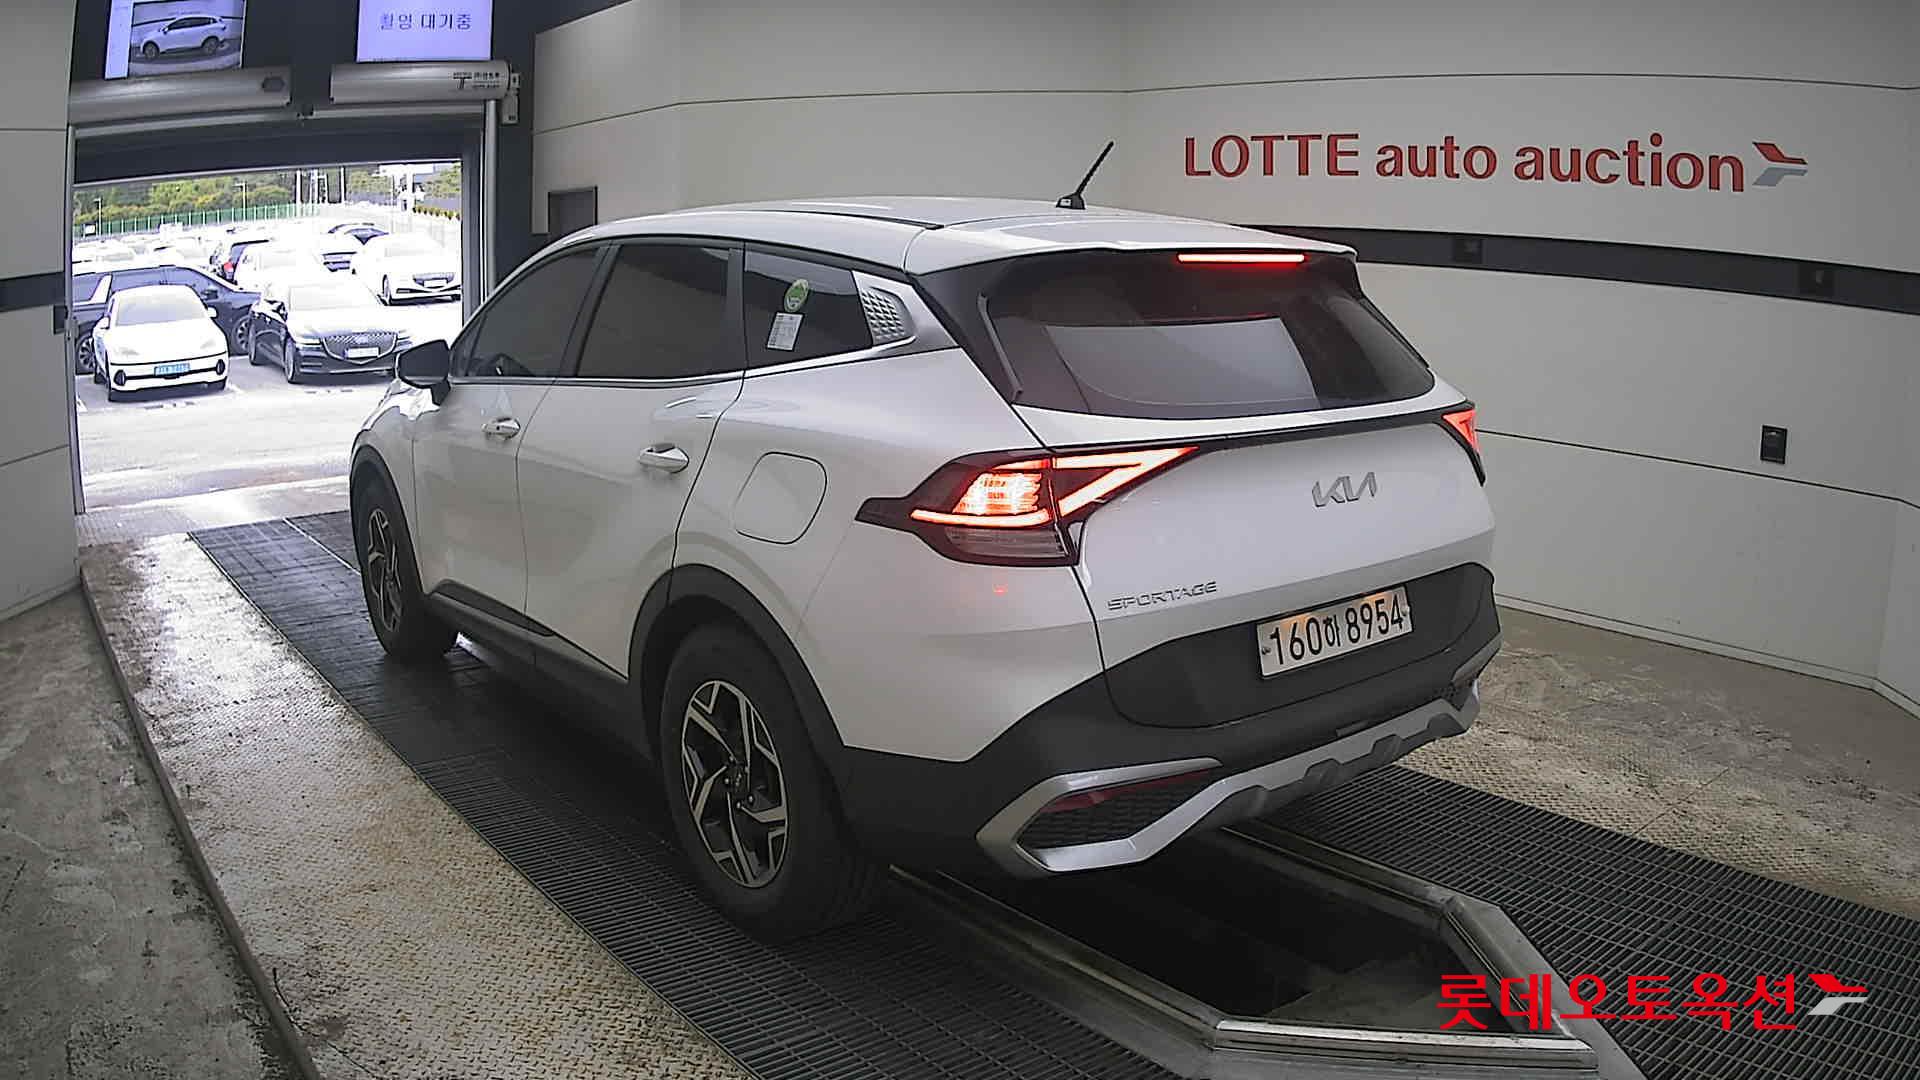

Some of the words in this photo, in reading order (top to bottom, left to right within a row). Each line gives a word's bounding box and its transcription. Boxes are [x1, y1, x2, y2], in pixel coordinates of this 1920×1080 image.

[421, 13, 472, 30] 대기중
[1184, 133, 1360, 178] LOTTE
[1375, 135, 1498, 180] auto
[1513, 132, 1745, 193] auction
[1311, 471, 1378, 508] KIA
[1106, 581, 1218, 611] SPORTAGE
[1268, 614, 1342, 666] 160하
[1344, 593, 1404, 644] 8954
